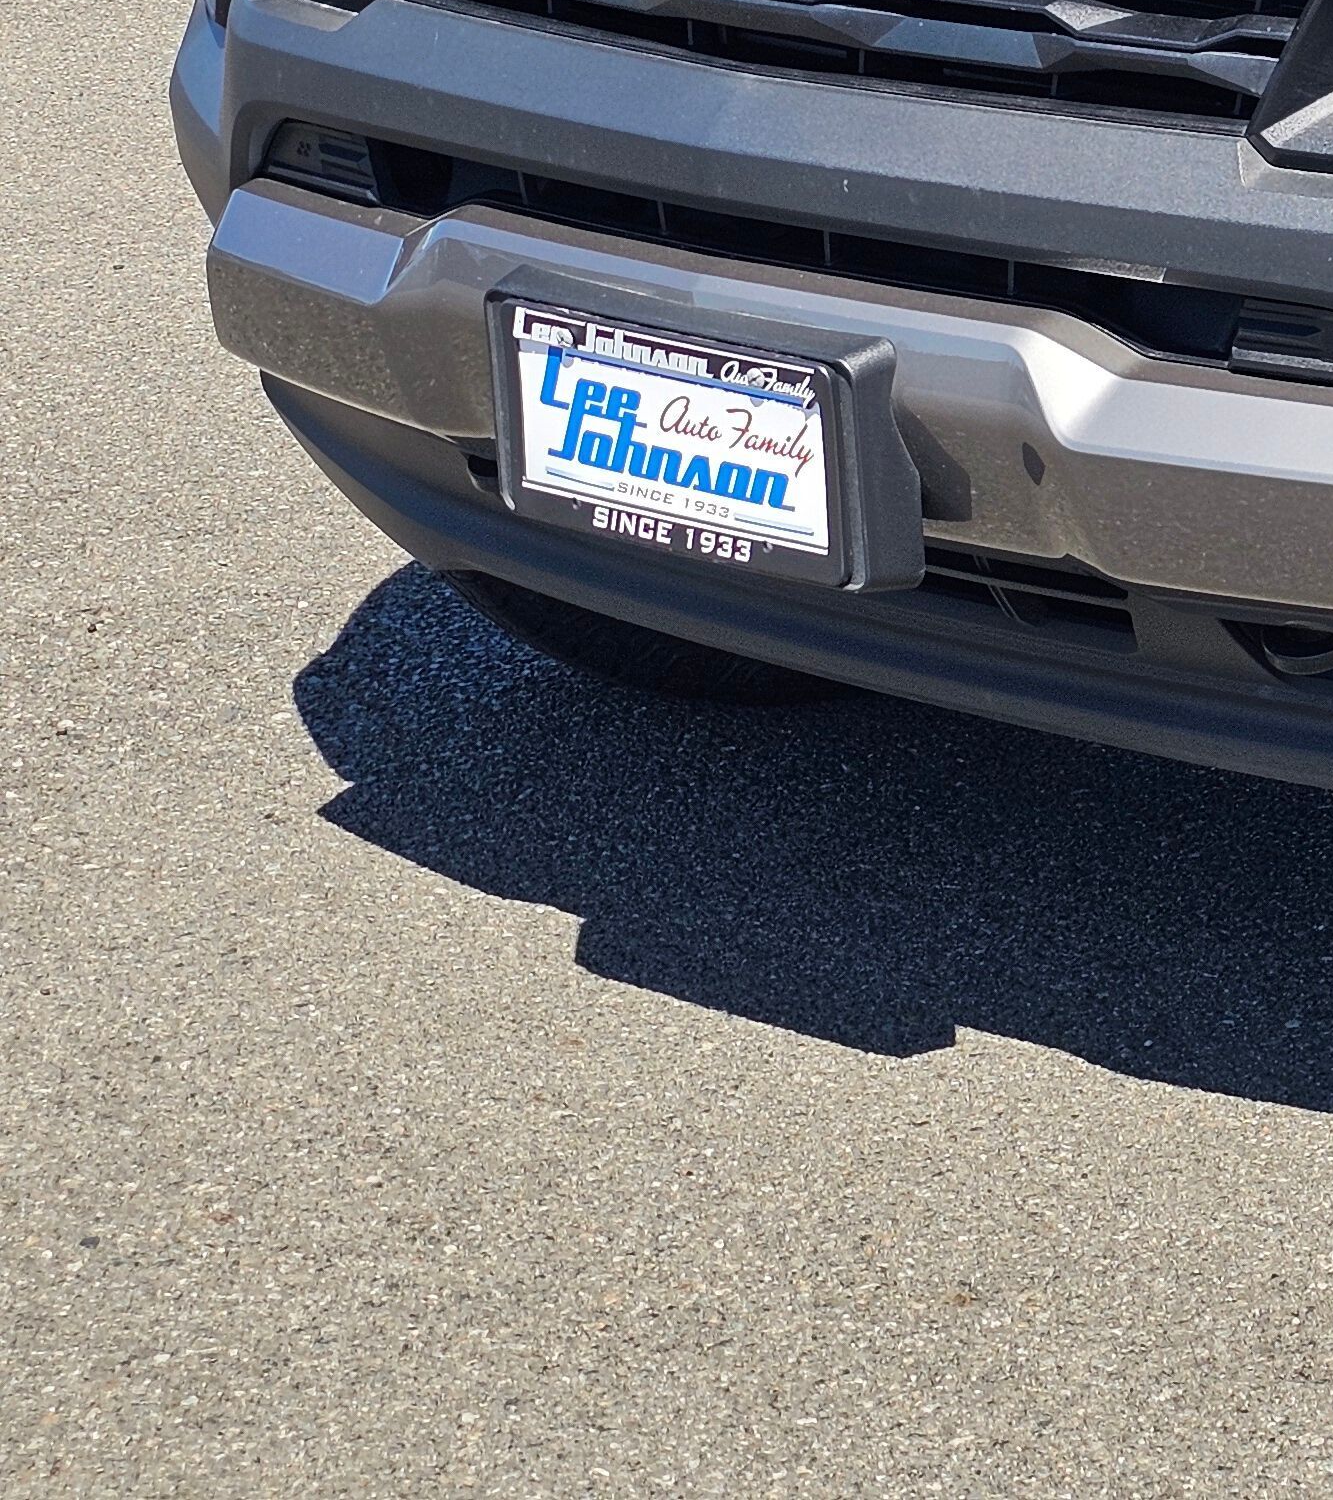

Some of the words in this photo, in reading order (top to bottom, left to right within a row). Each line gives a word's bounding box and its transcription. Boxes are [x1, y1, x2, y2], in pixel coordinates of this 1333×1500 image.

[540, 347, 647, 428] Lee
[577, 322, 715, 379] Johnson
[720, 360, 764, 386] Au
[759, 367, 815, 409] Family
[547, 412, 796, 512] Johnson
[660, 396, 722, 442] Auto
[726, 408, 814, 478] Family
[592, 506, 674, 544] SINCE
[685, 528, 752, 563] 1933
[617, 482, 674, 505] SINCE
[685, 498, 730, 519] 1933
